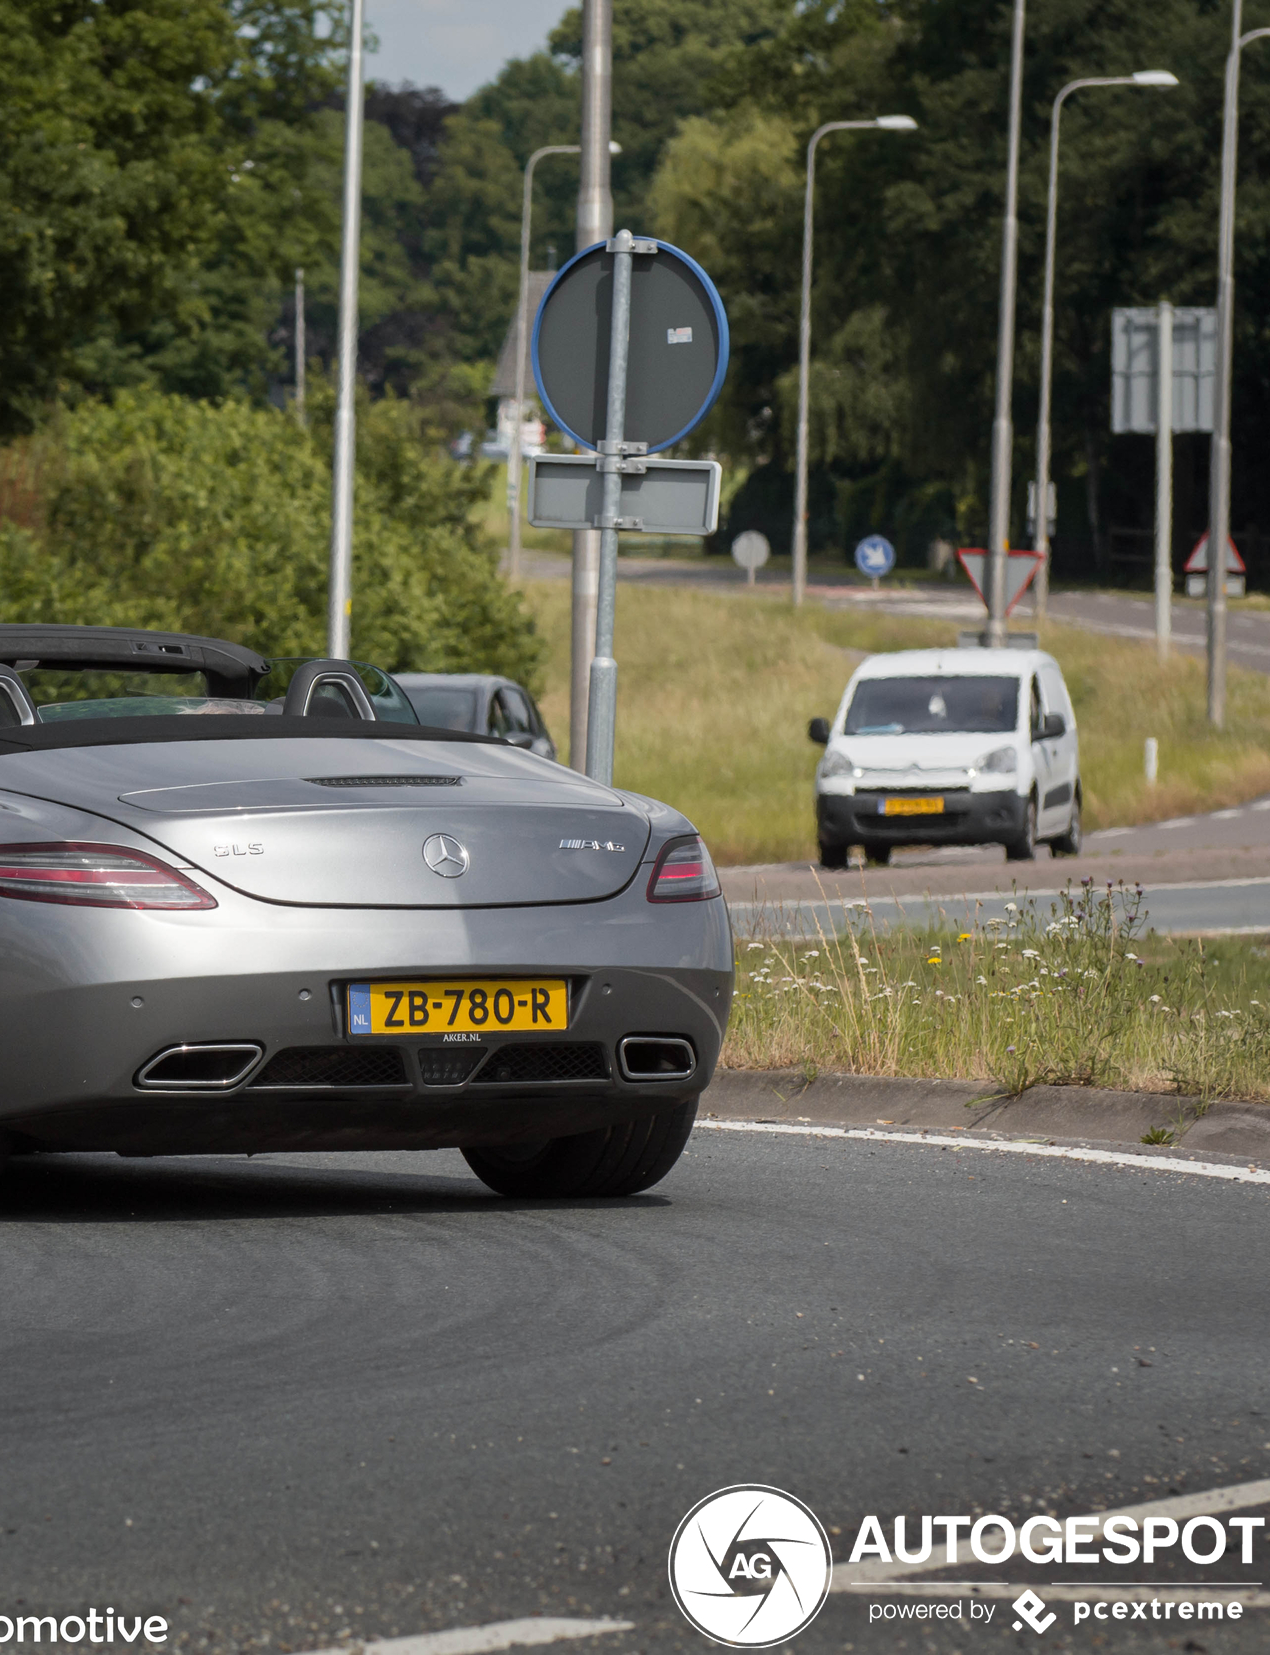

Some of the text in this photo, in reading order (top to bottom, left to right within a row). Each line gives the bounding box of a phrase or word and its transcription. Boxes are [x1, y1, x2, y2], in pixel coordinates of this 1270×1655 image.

[213, 843, 265, 858] SLS
[384, 988, 552, 1027] ZB-780-R
[353, 1014, 369, 1026] NL
